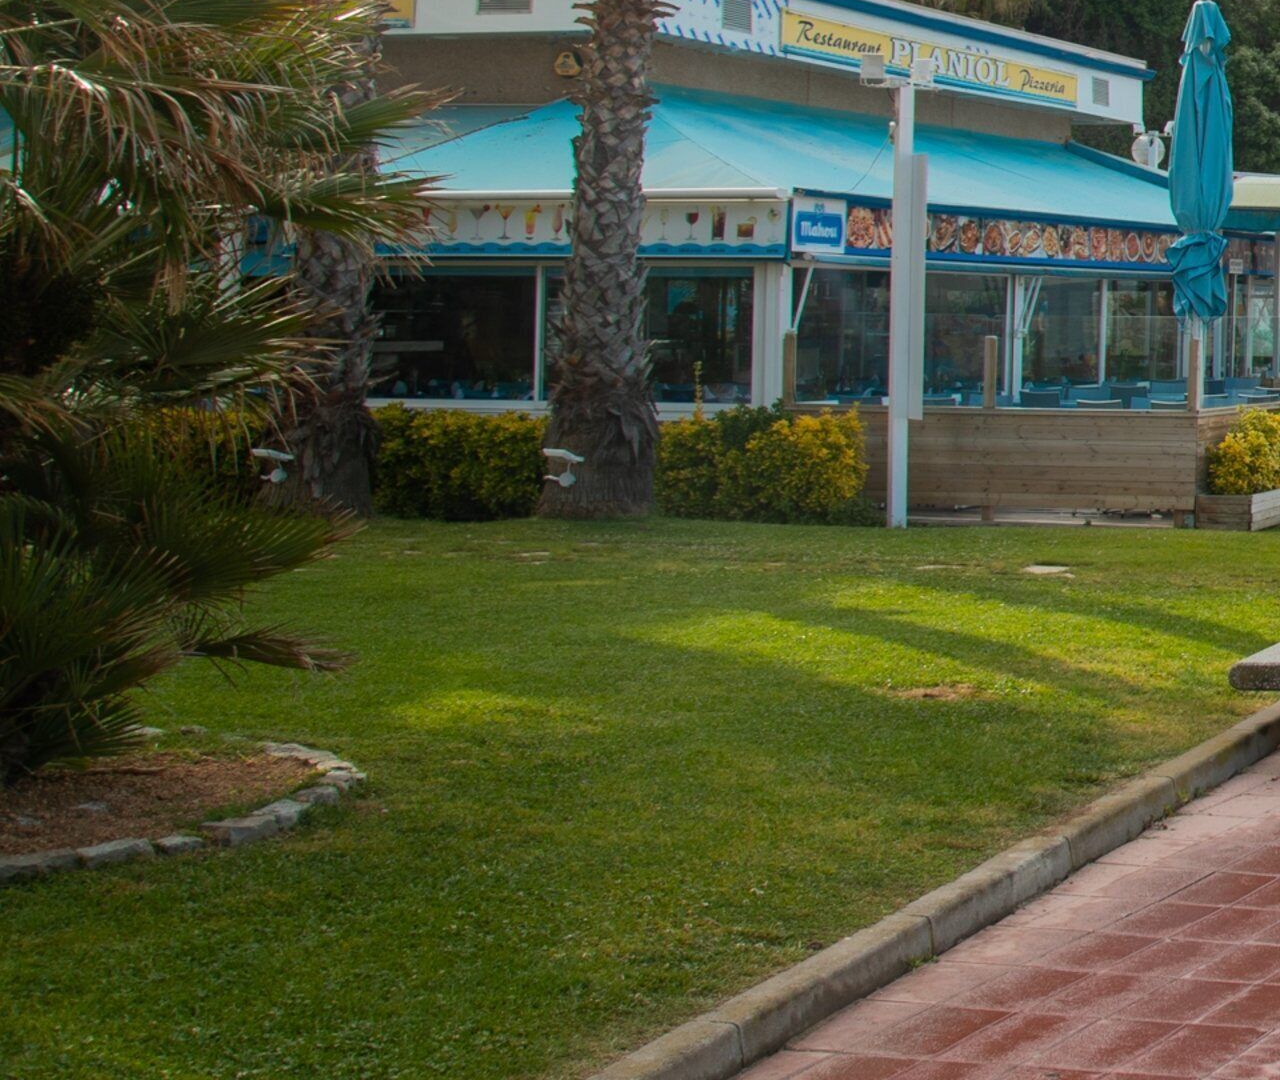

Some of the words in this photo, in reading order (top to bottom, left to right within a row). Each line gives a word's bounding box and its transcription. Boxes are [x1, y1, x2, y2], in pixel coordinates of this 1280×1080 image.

[796, 20, 882, 54] Restaurant
[1019, 69, 1065, 95] Pizzeria
[800, 220, 838, 238] Mahou
